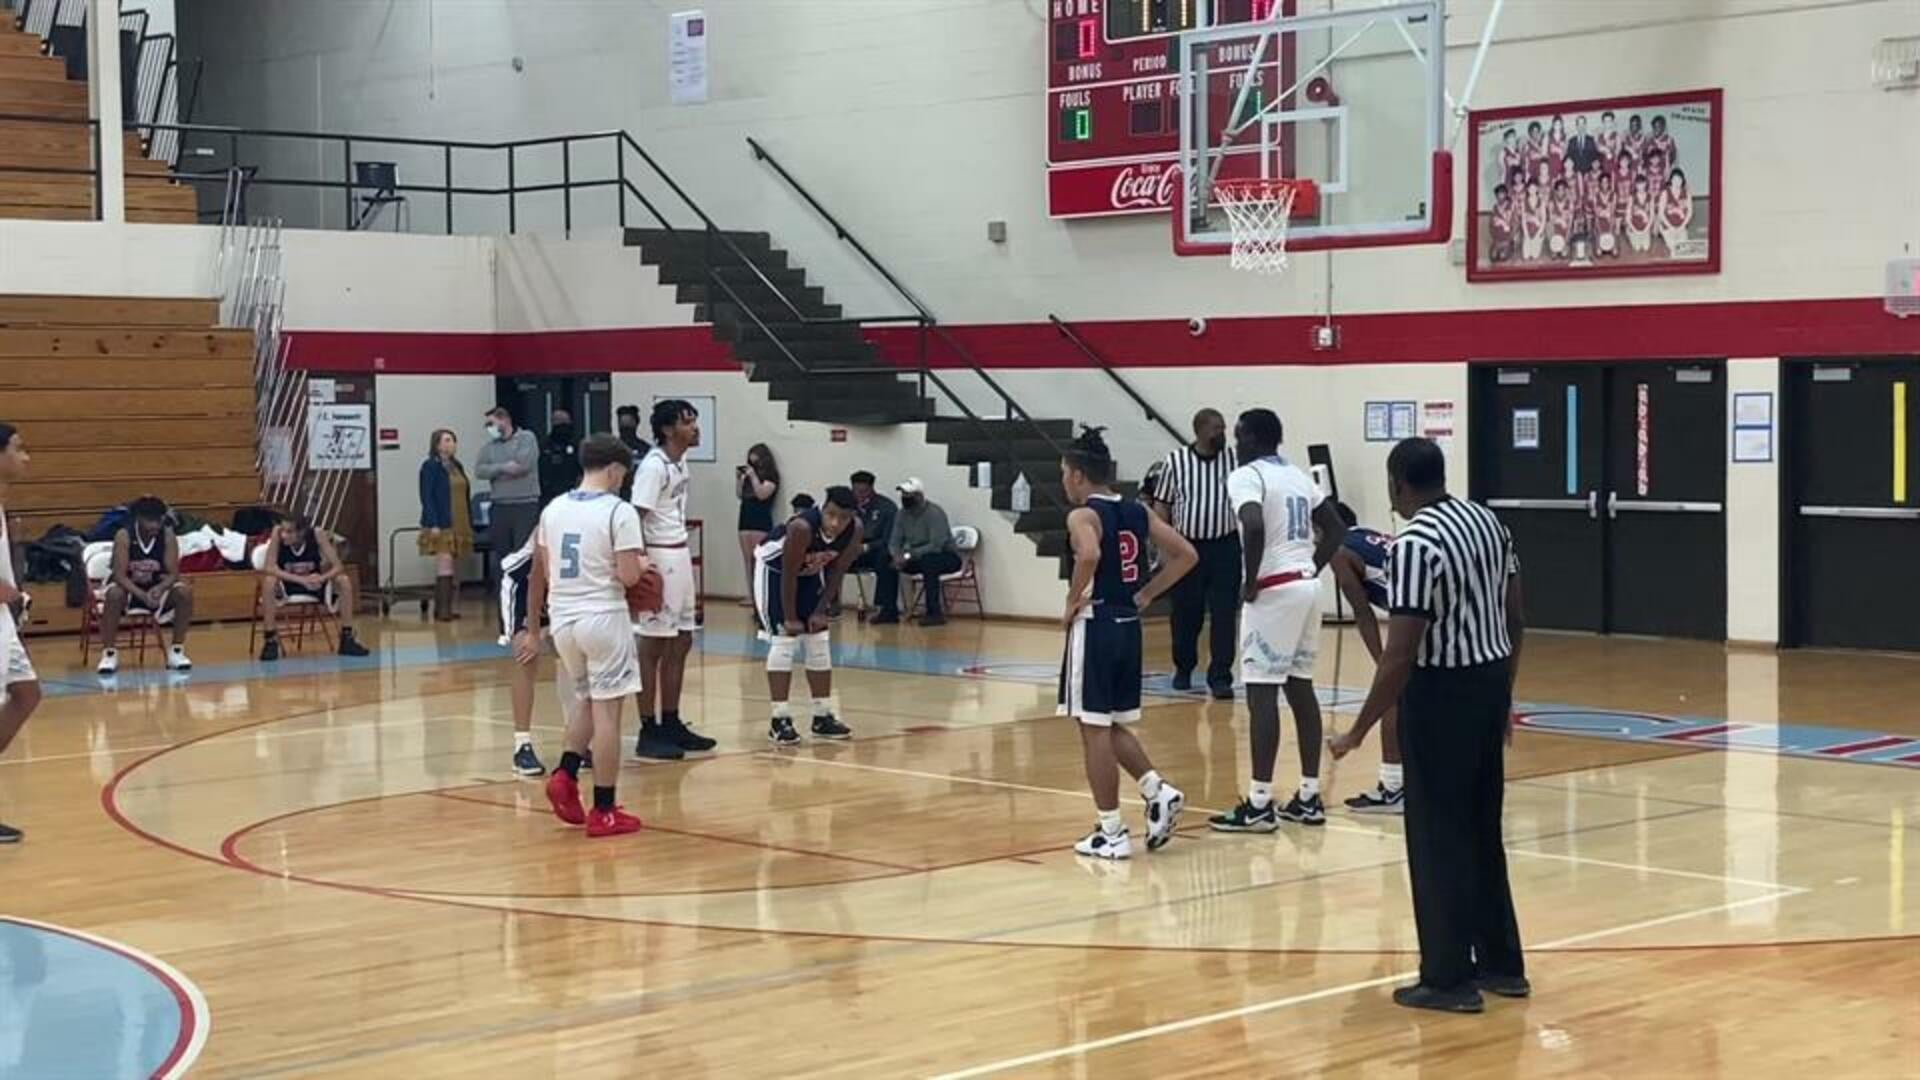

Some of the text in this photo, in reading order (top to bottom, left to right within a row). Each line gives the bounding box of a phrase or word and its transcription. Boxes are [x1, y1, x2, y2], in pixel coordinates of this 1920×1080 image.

[1079, 20, 1095, 57] 0
[1218, 43, 1256, 63] BONUS
[1068, 63, 1102, 81] BONUS
[1133, 54, 1167, 72] PERIOD
[1059, 91, 1091, 109] FOULS
[1123, 82, 1162, 102] PLAYER
[1076, 110, 1089, 139] 0
[1110, 163, 1189, 209] Coca-C
[1285, 495, 1309, 541] 10
[559, 532, 582, 579] 5
[1119, 530, 1140, 583] 2
